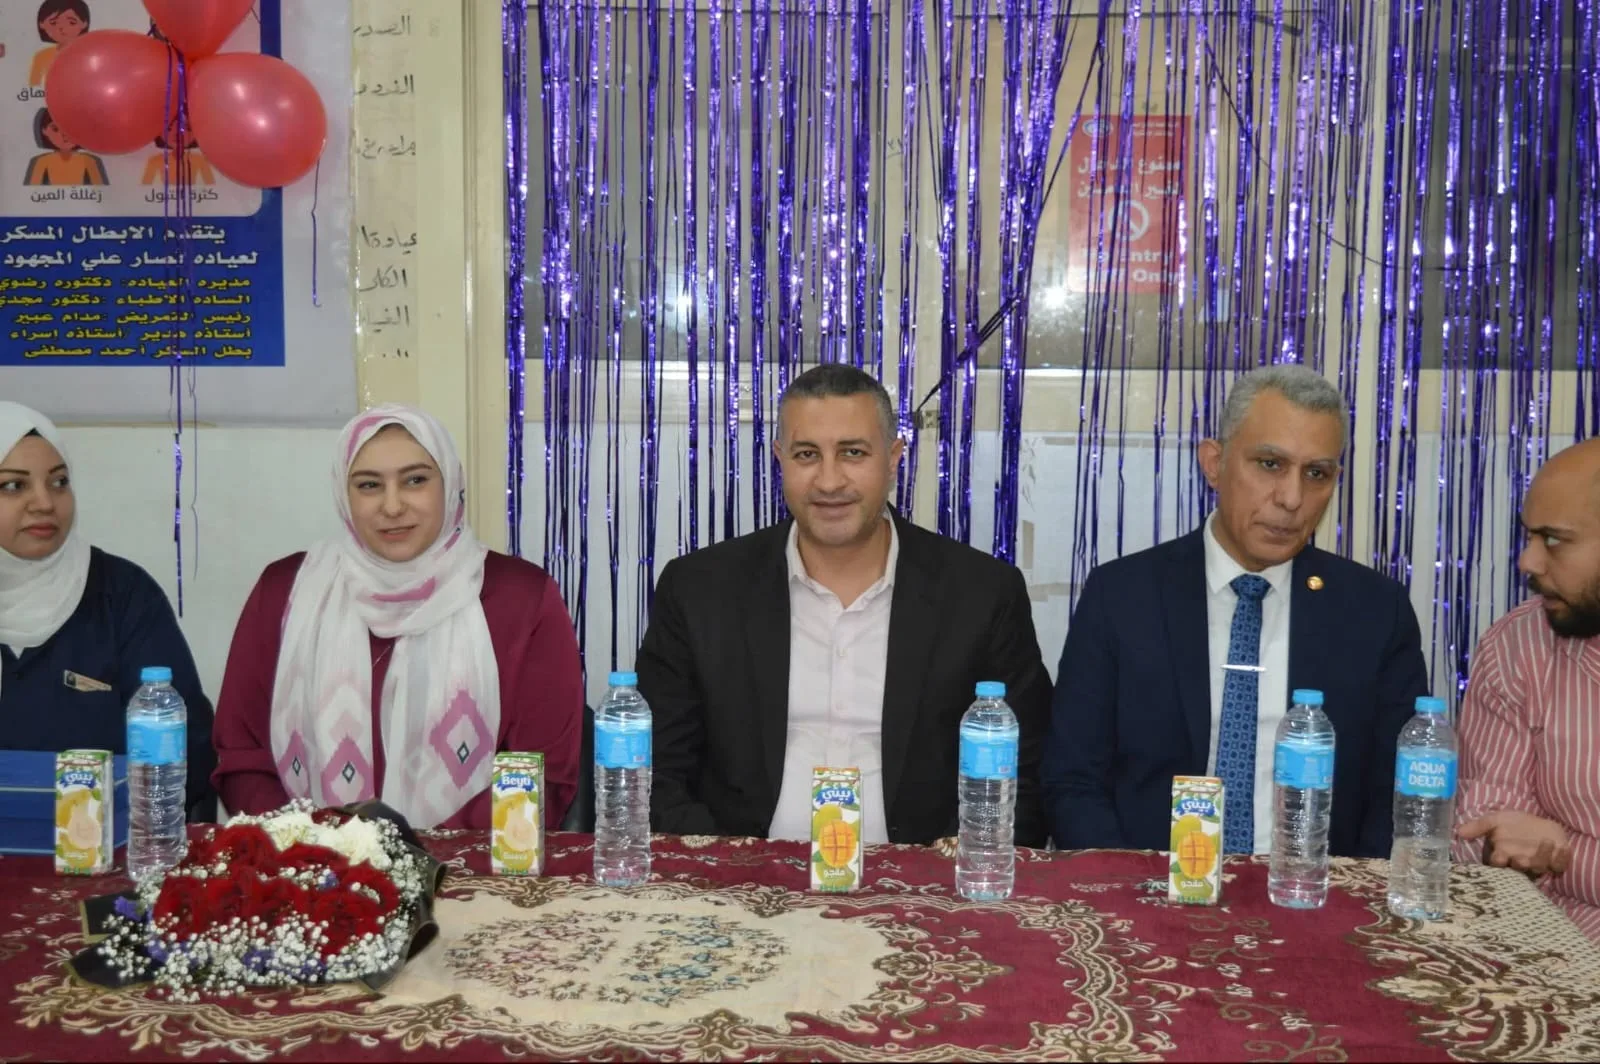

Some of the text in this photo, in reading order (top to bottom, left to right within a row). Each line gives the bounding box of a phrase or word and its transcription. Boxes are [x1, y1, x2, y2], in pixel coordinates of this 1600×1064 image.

[30, 188, 65, 203] العين
[4, 250, 72, 269] المجهود
[1409, 761, 1446, 775] AQUA
[1407, 774, 1446, 788] DELTA
